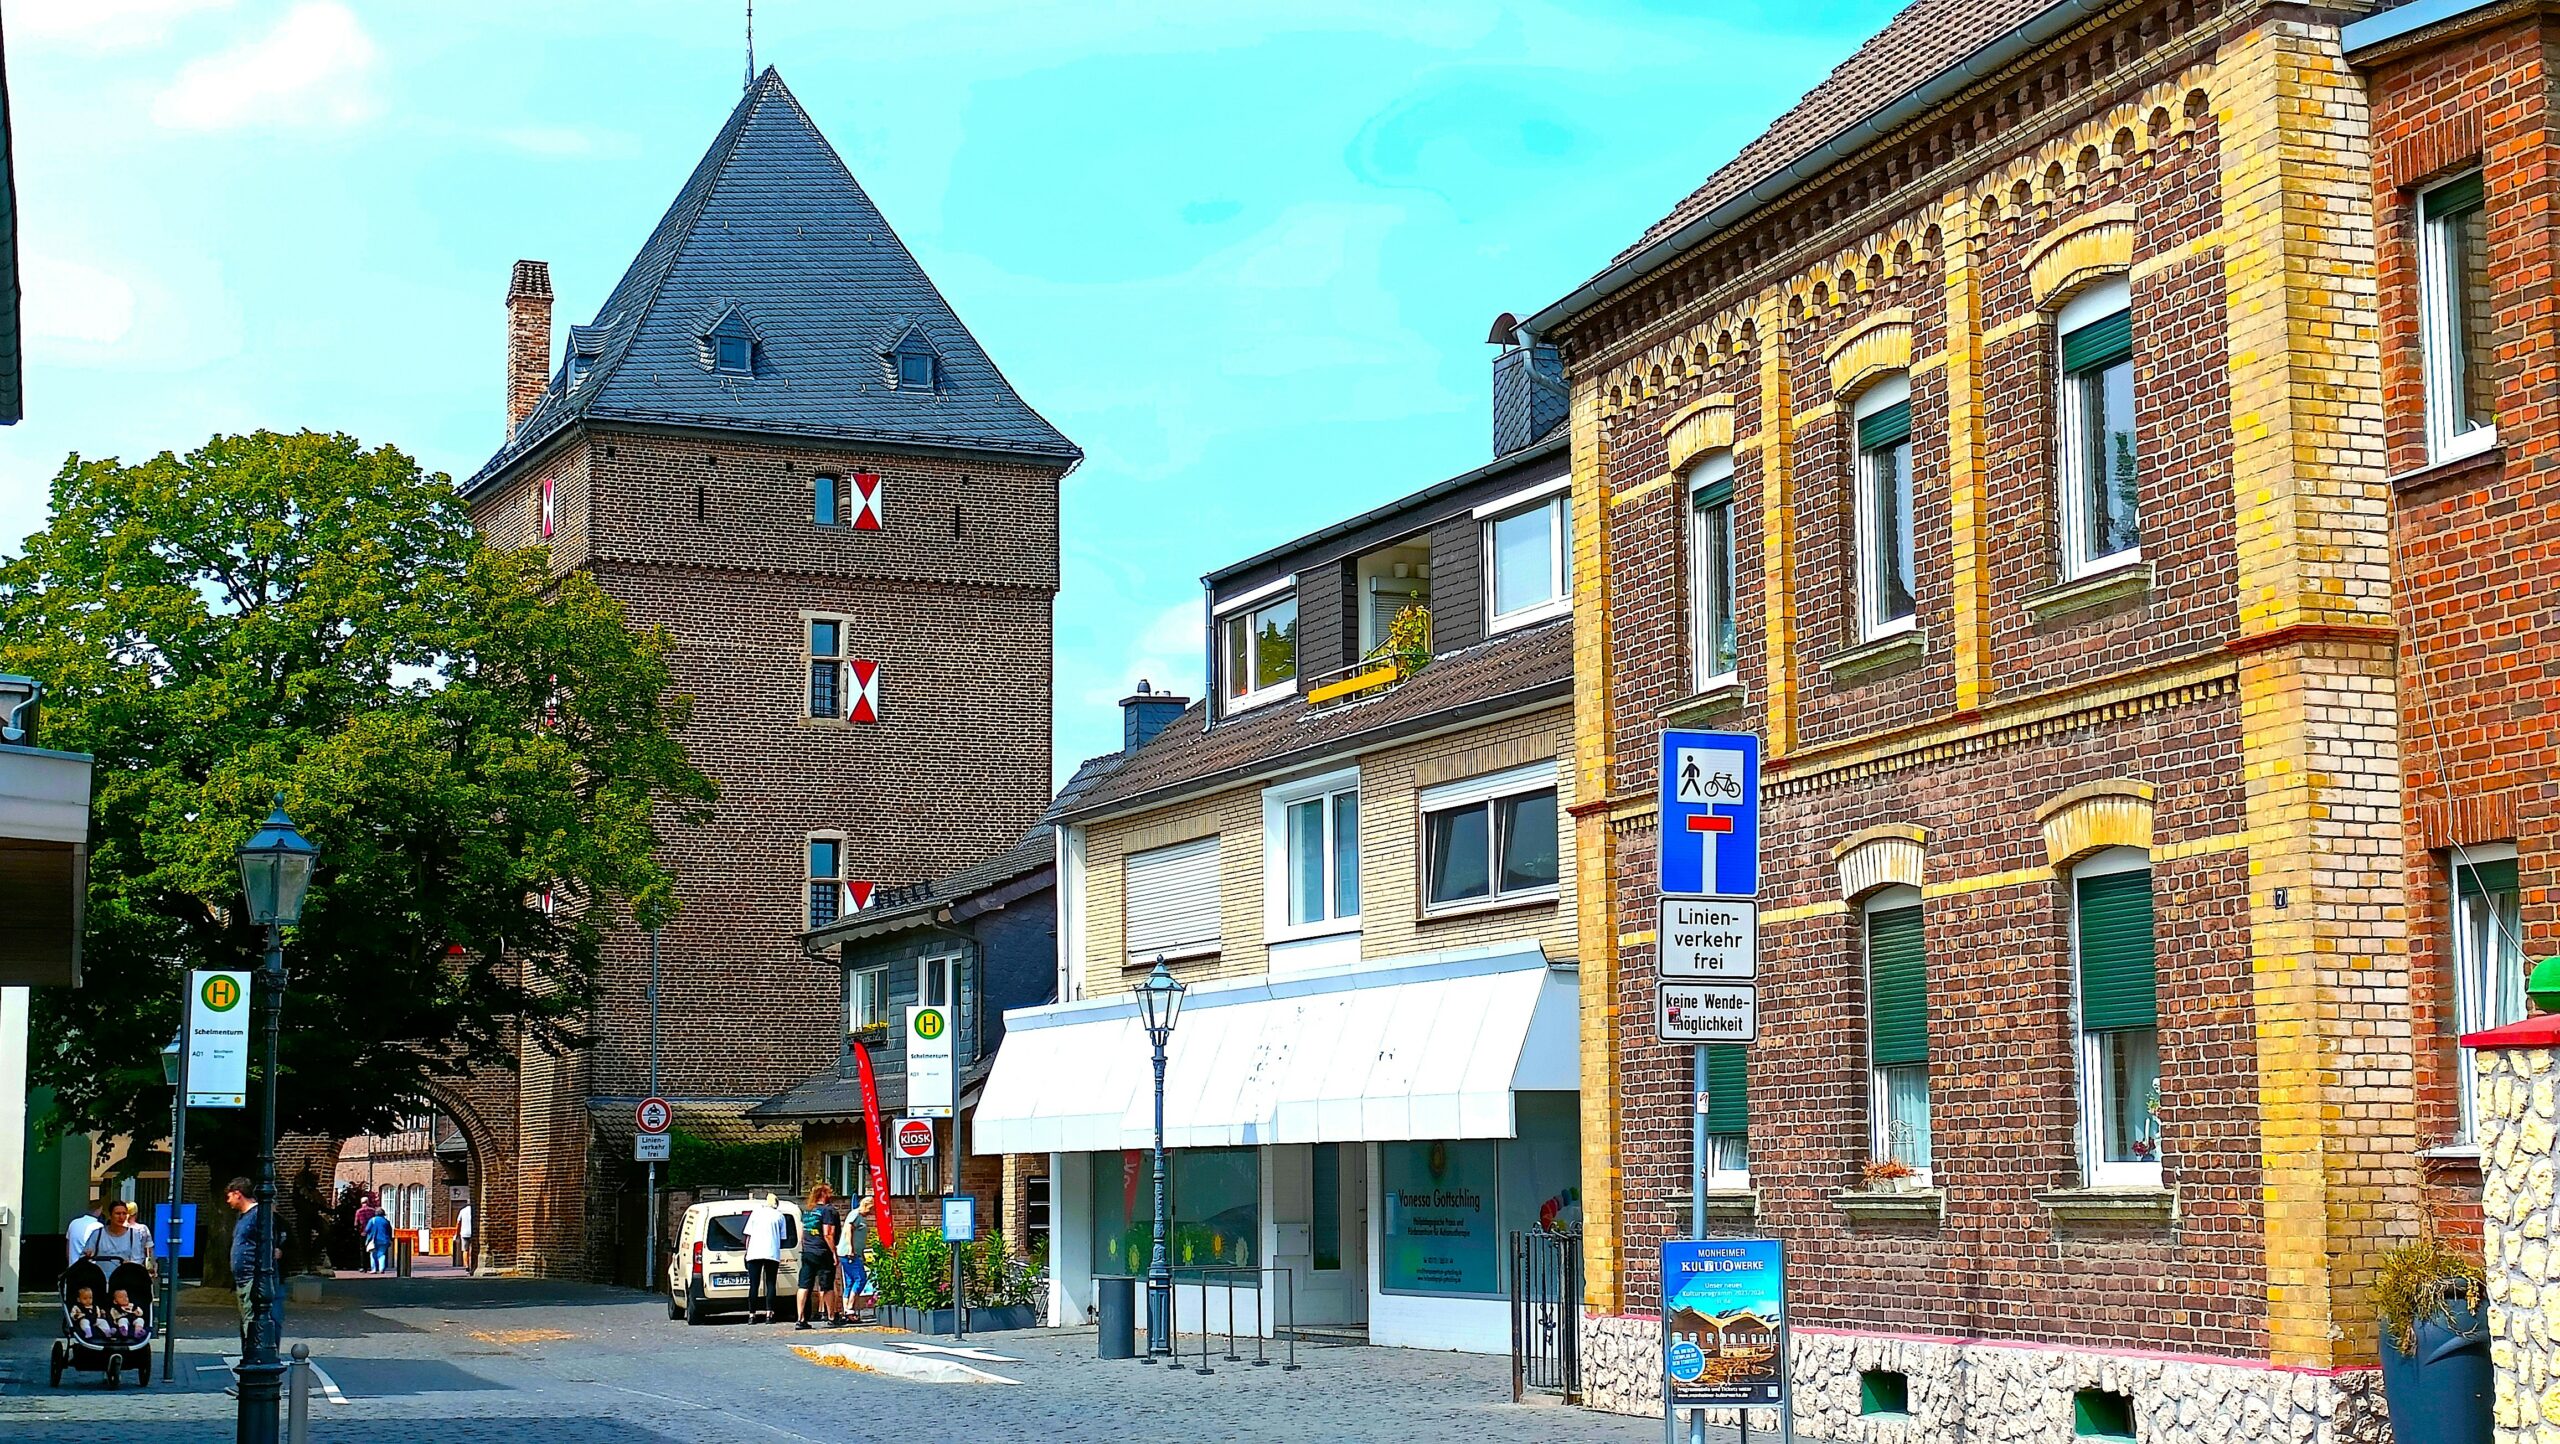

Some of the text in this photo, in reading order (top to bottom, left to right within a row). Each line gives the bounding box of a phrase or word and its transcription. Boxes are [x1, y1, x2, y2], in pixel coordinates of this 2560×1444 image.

[2276, 890, 2284, 906] 7
[1678, 907, 1739, 926] Linien-
[1674, 931, 1743, 948] verkehr
[1694, 953, 1723, 970] frei
[1666, 993, 1750, 1009] keine Wende-
[194, 1028, 244, 1036] Schelmenturm
[1672, 1016, 1743, 1034] möglichkeit
[900, 1131, 931, 1144] KIOSK
[1398, 1189, 1480, 1212] Vanessa Gottschling
[1698, 1248, 1746, 1257] MONHEIMER
[1681, 1259, 1764, 1272] KULTURWERKE
[1682, 1290, 1733, 1298] Kulturprogramm
